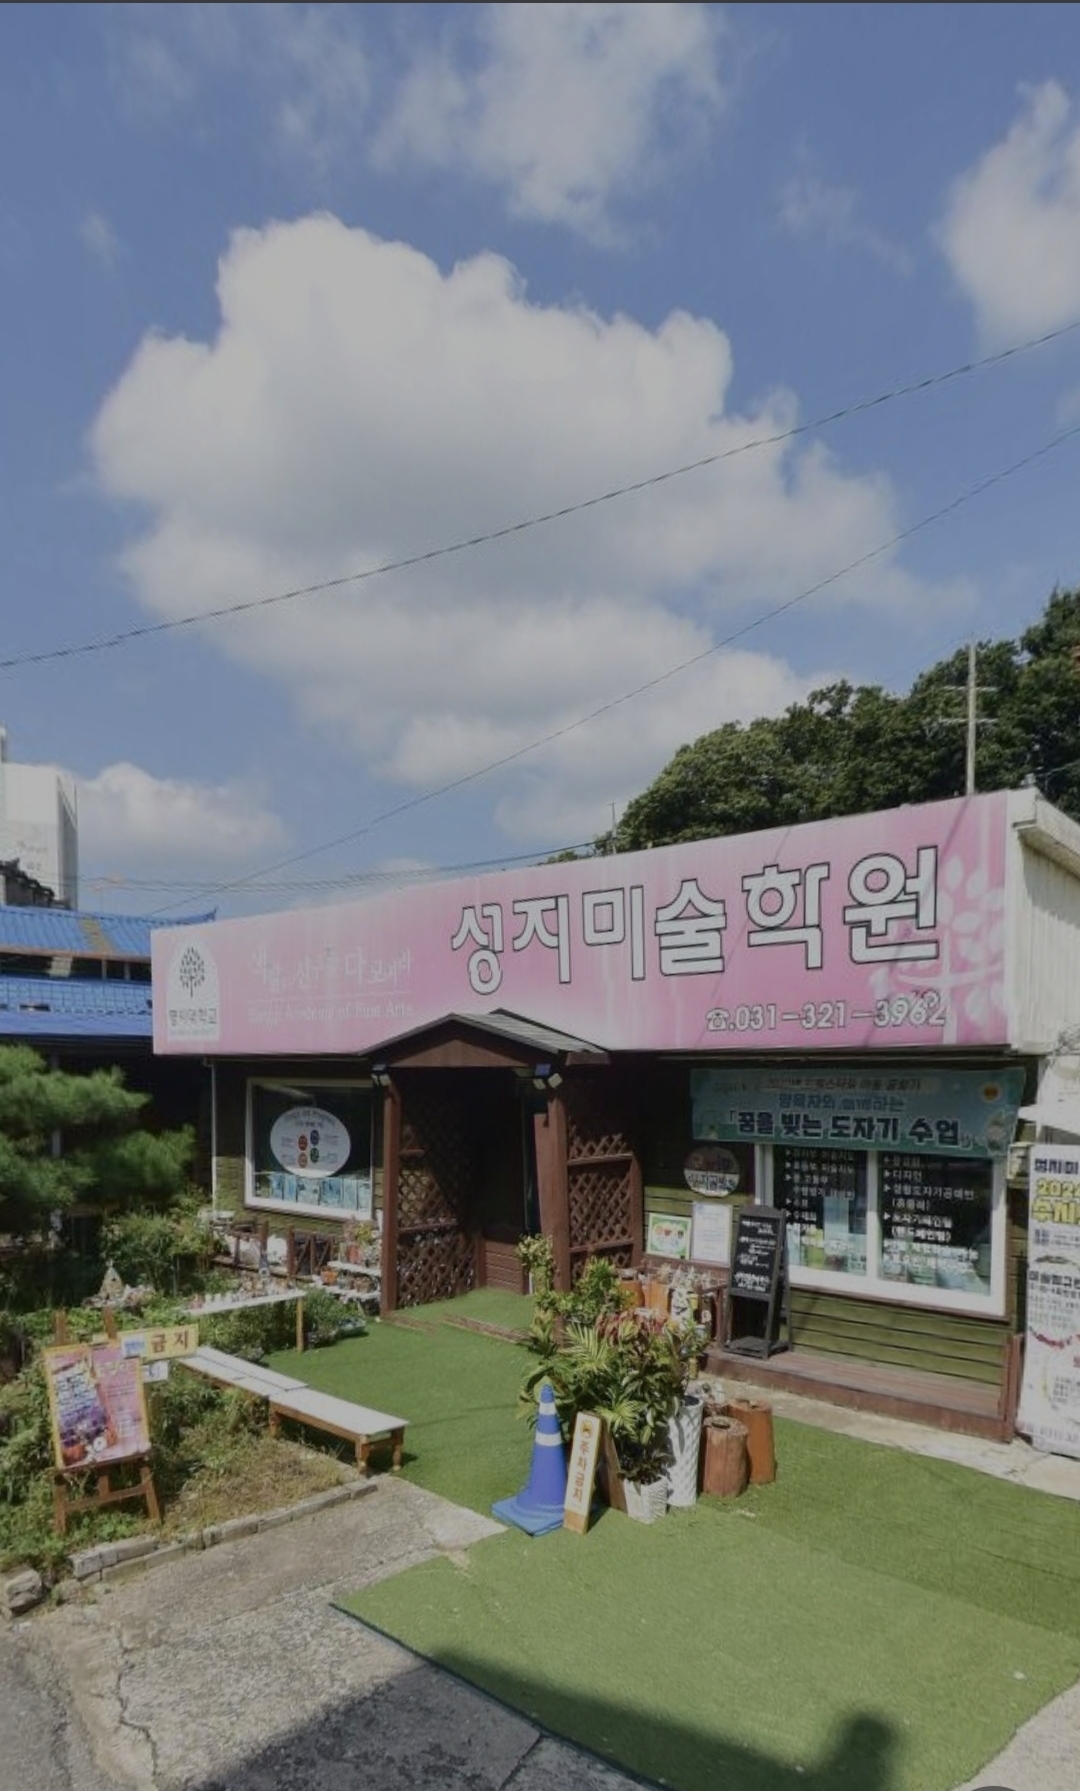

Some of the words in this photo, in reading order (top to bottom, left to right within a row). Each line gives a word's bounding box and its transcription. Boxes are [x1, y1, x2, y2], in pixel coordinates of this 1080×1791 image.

[451, 845, 940, 997] 성지미술학원
[781, 1113, 822, 1137] 빚는
[829, 1116, 900, 1141] 도자기
[1032, 1196, 1080, 1224] 수시
[150, 1330, 189, 1354] 금지
